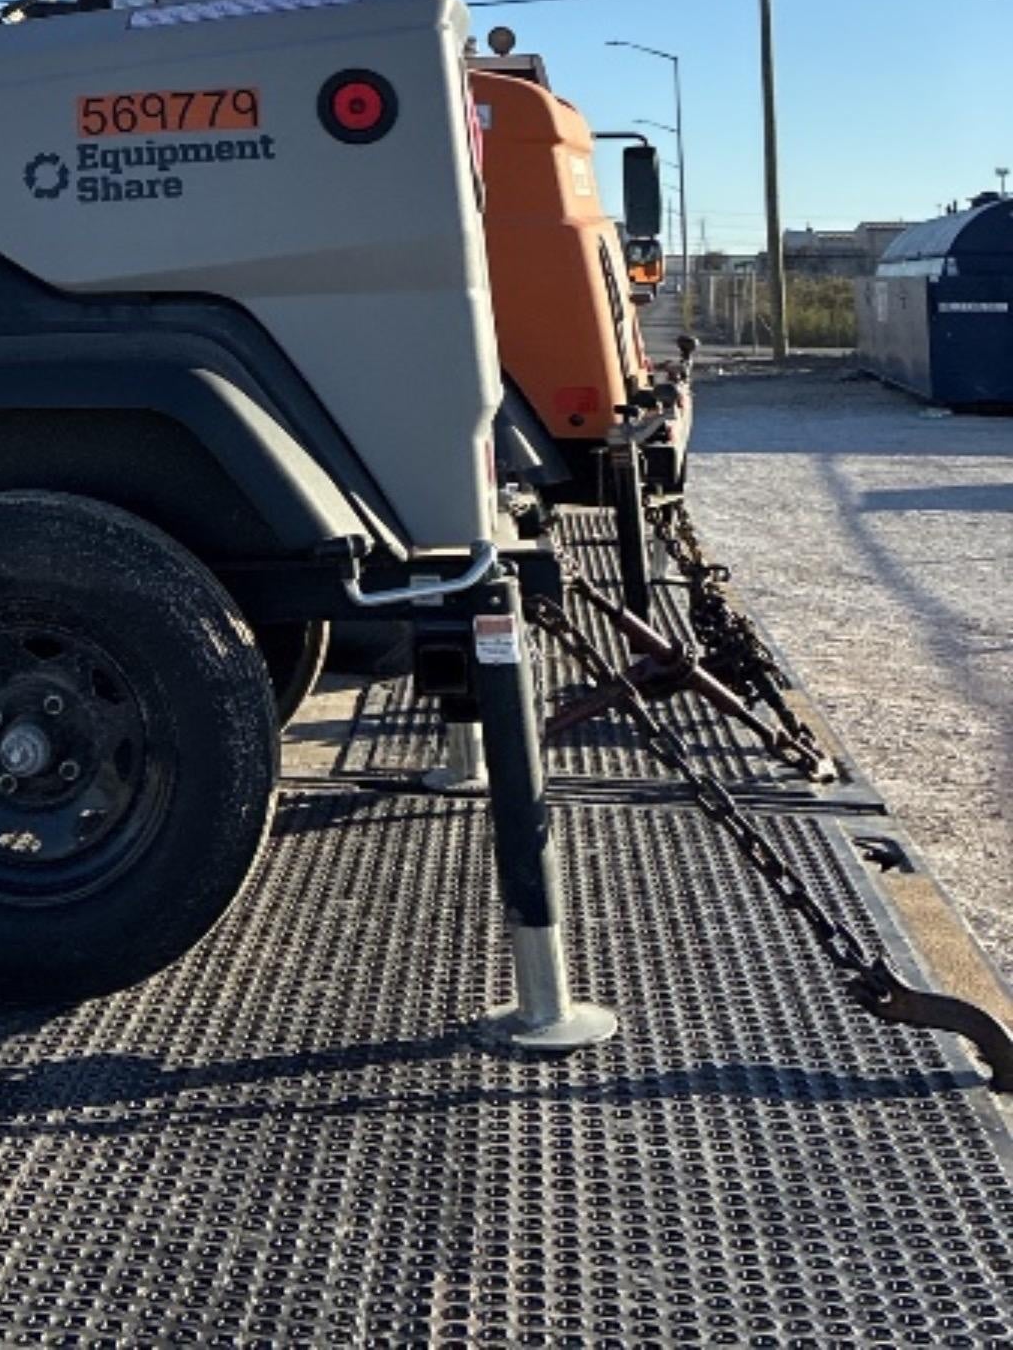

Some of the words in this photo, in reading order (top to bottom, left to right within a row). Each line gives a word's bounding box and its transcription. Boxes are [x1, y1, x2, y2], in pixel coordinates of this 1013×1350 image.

[81, 89, 259, 135] 569779
[76, 134, 275, 174] Equipment
[76, 176, 183, 203] Share
